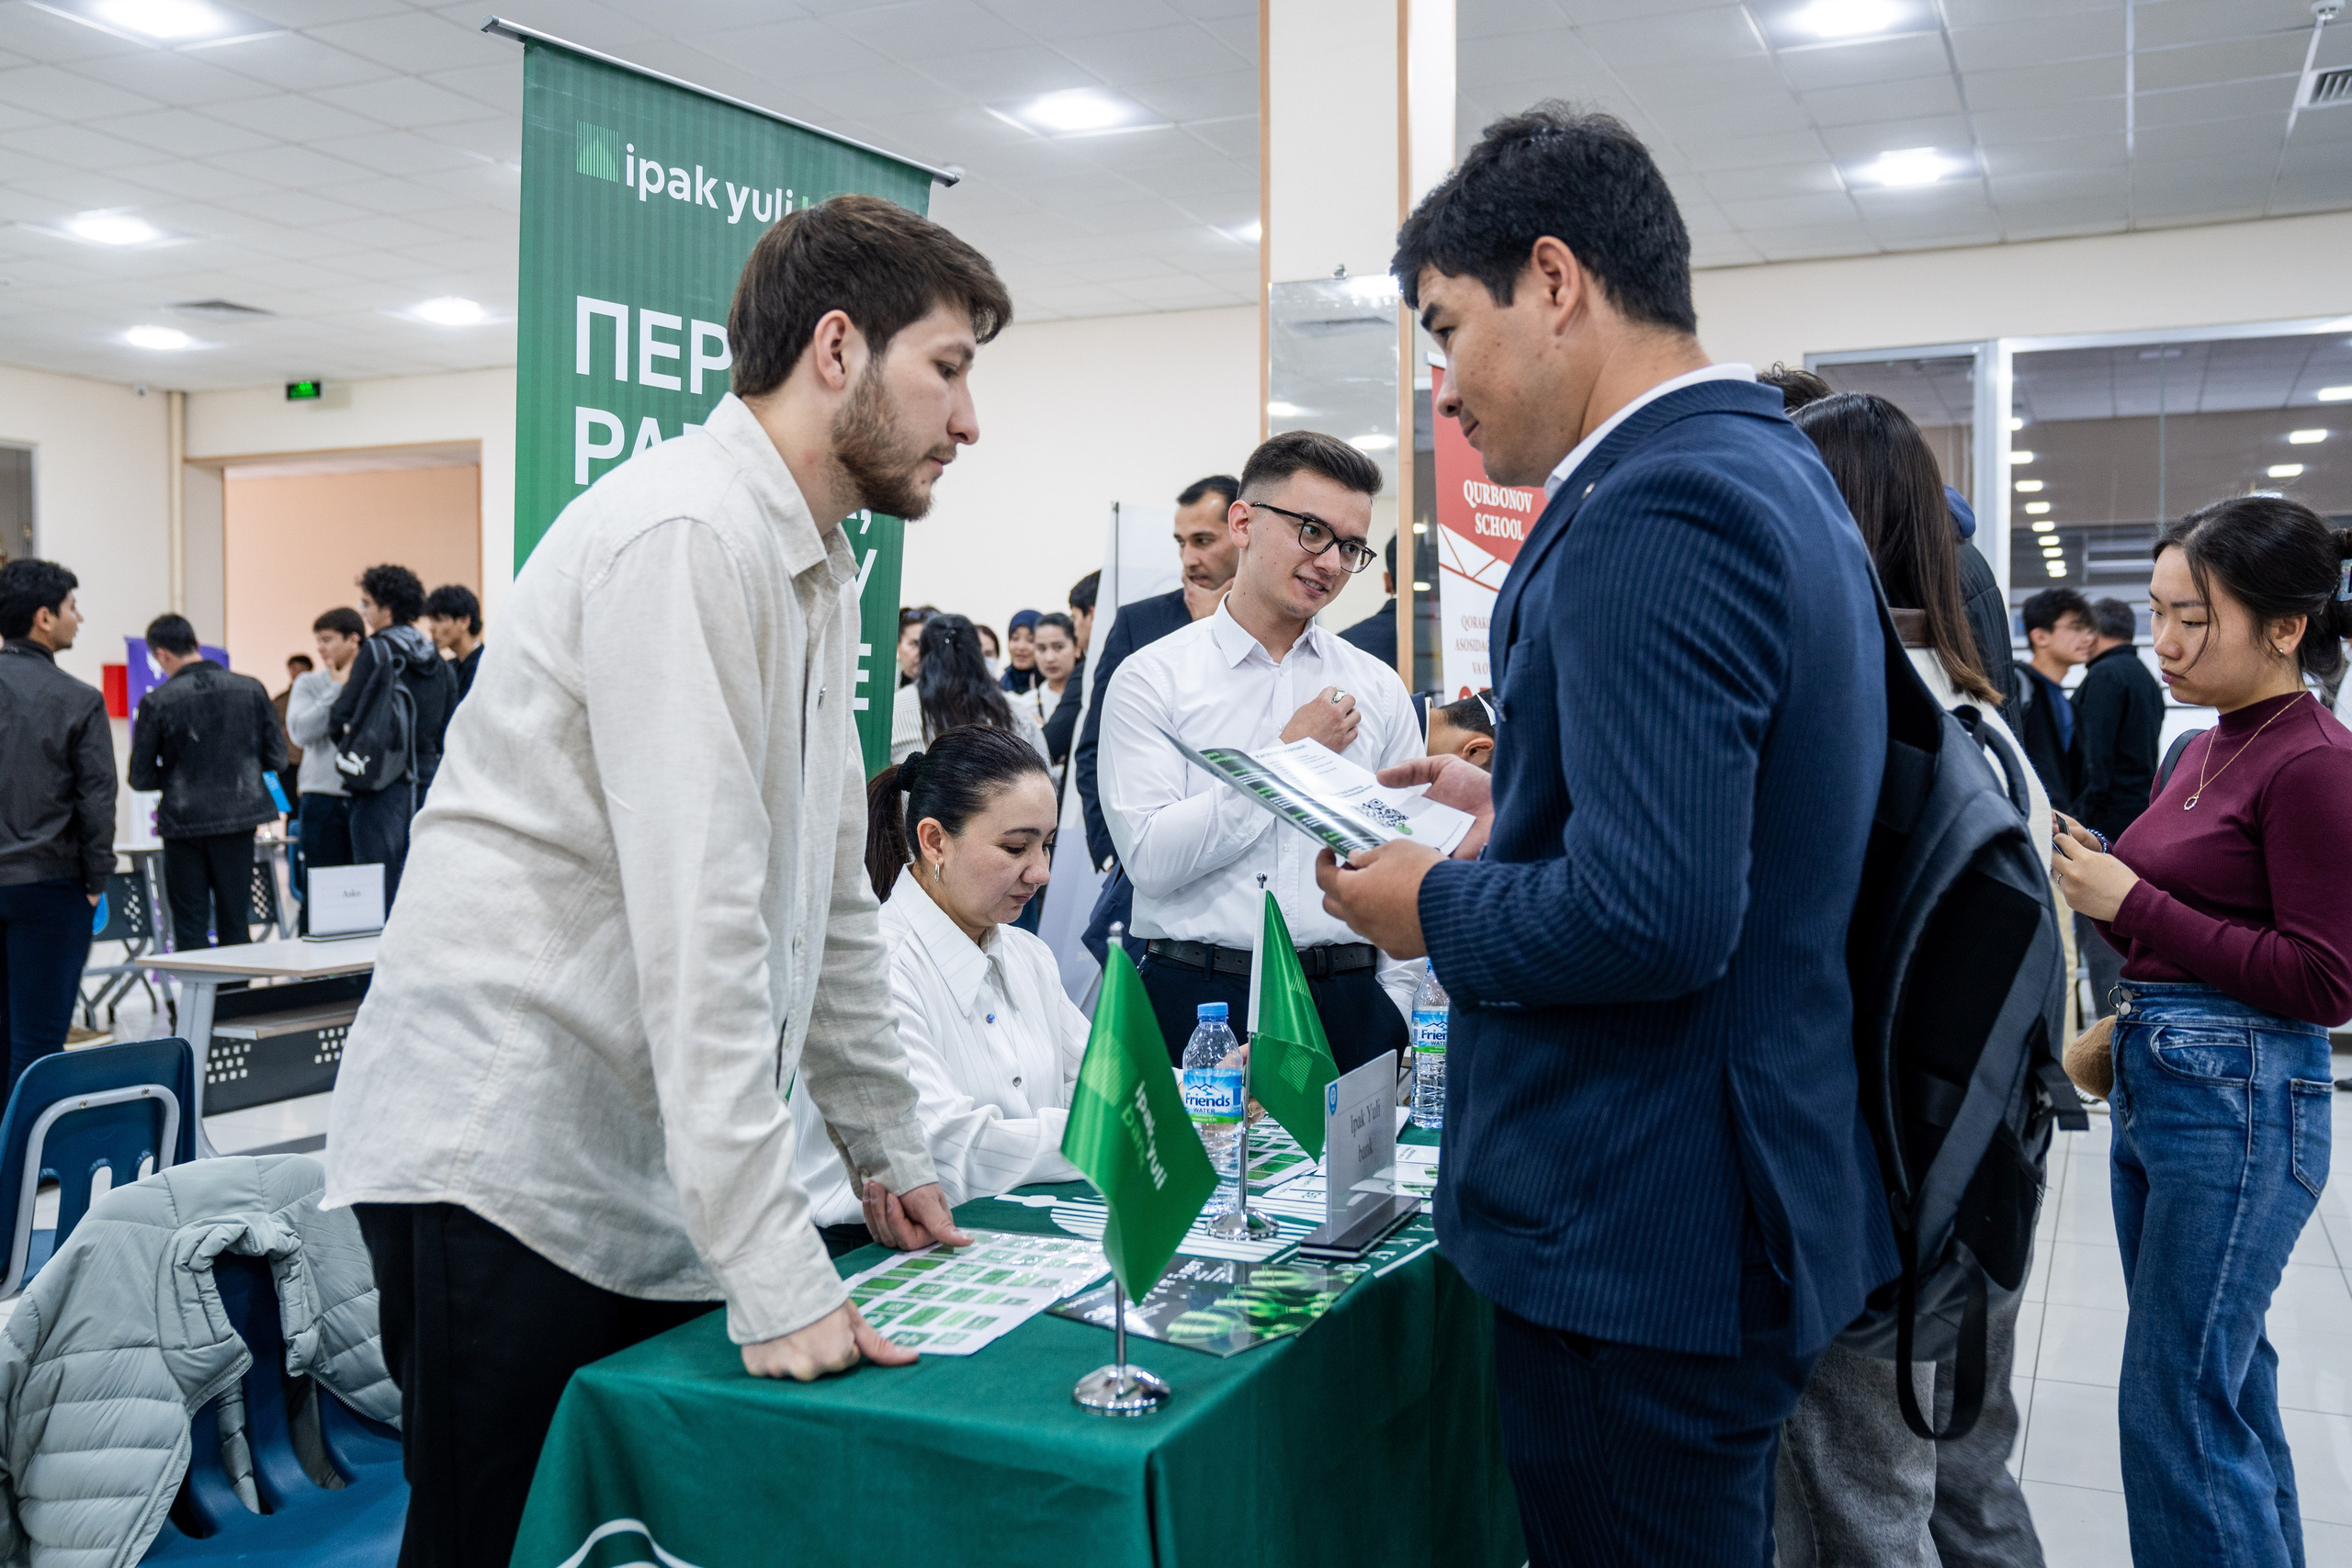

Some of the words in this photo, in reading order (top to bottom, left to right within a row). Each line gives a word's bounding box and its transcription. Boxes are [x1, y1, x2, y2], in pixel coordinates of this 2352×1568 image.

[626, 143, 718, 209] ipak
[726, 181, 794, 224] yuli
[576, 295, 733, 395] ПЕР
[1463, 479, 1533, 513] QURBONOV
[1475, 513, 1525, 541] SCHOOL
[1421, 1029, 1448, 1040] Frien
[1185, 1092, 1230, 1107] Friends
